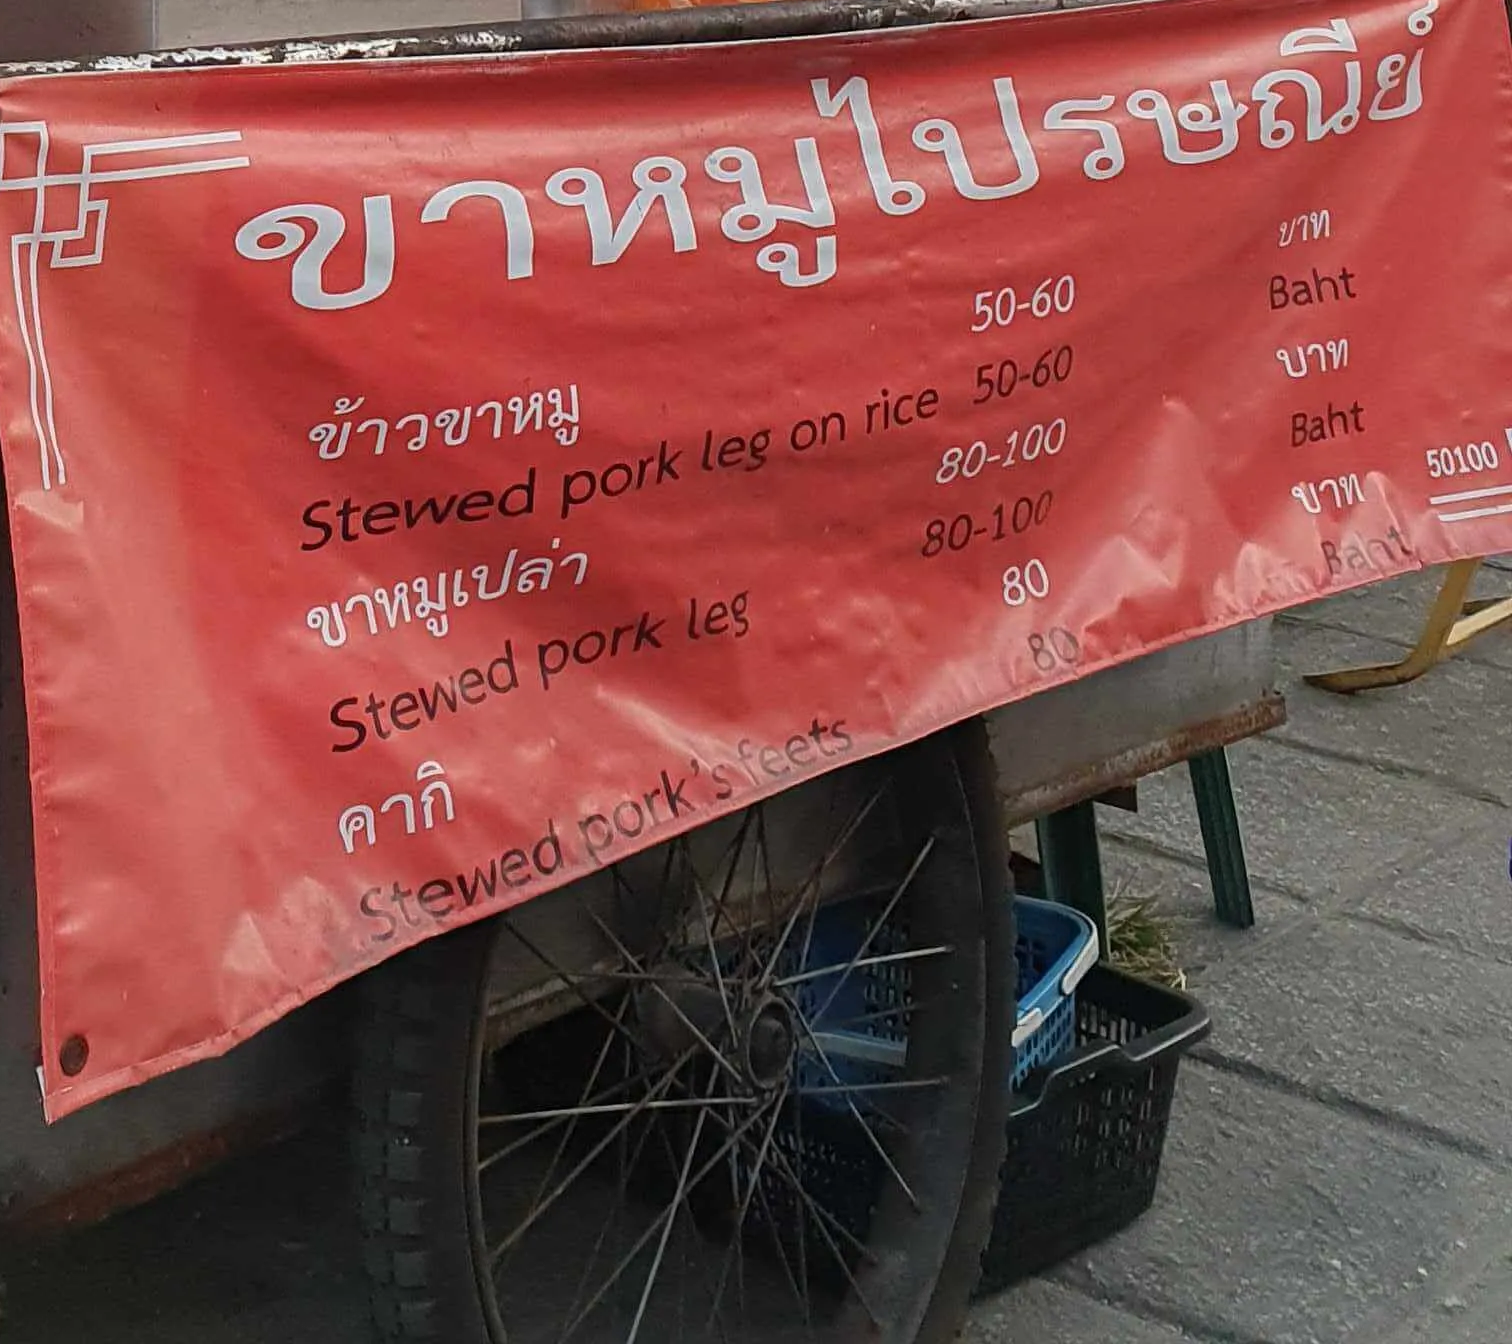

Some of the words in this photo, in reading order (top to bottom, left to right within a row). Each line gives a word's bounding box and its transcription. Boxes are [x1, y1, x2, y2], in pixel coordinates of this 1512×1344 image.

[300, 467, 536, 552] Stewed
[561, 442, 683, 517] pork
[701, 430, 772, 474] leg
[790, 412, 847, 452] on
[865, 386, 939, 433] rice
[973, 345, 1073, 405] 50-60
[1269, 267, 1357, 310] Baht
[308, 382, 581, 461] ข้าวขาหมู
[971, 275, 1076, 332] 50-60
[1277, 209, 1331, 248] บาท
[1426, 441, 1499, 479] 50100
[306, 537, 589, 648] ขาหมูเปล่า
[935, 417, 1067, 485] 80-100
[1276, 337, 1349, 379] บาท
[330, 653, 519, 753] Stewed
[538, 612, 668, 690] pork
[688, 590, 750, 642] leg
[921, 490, 1054, 558] 80-100
[1291, 400, 1365, 449] Baht
[338, 760, 455, 854] คากิ
[1002, 558, 1050, 607] 80
[1291, 472, 1366, 515] บาท
[360, 819, 564, 943] Stewed
[1027, 626, 1081, 672] 80
[1321, 523, 1414, 576] Baht
